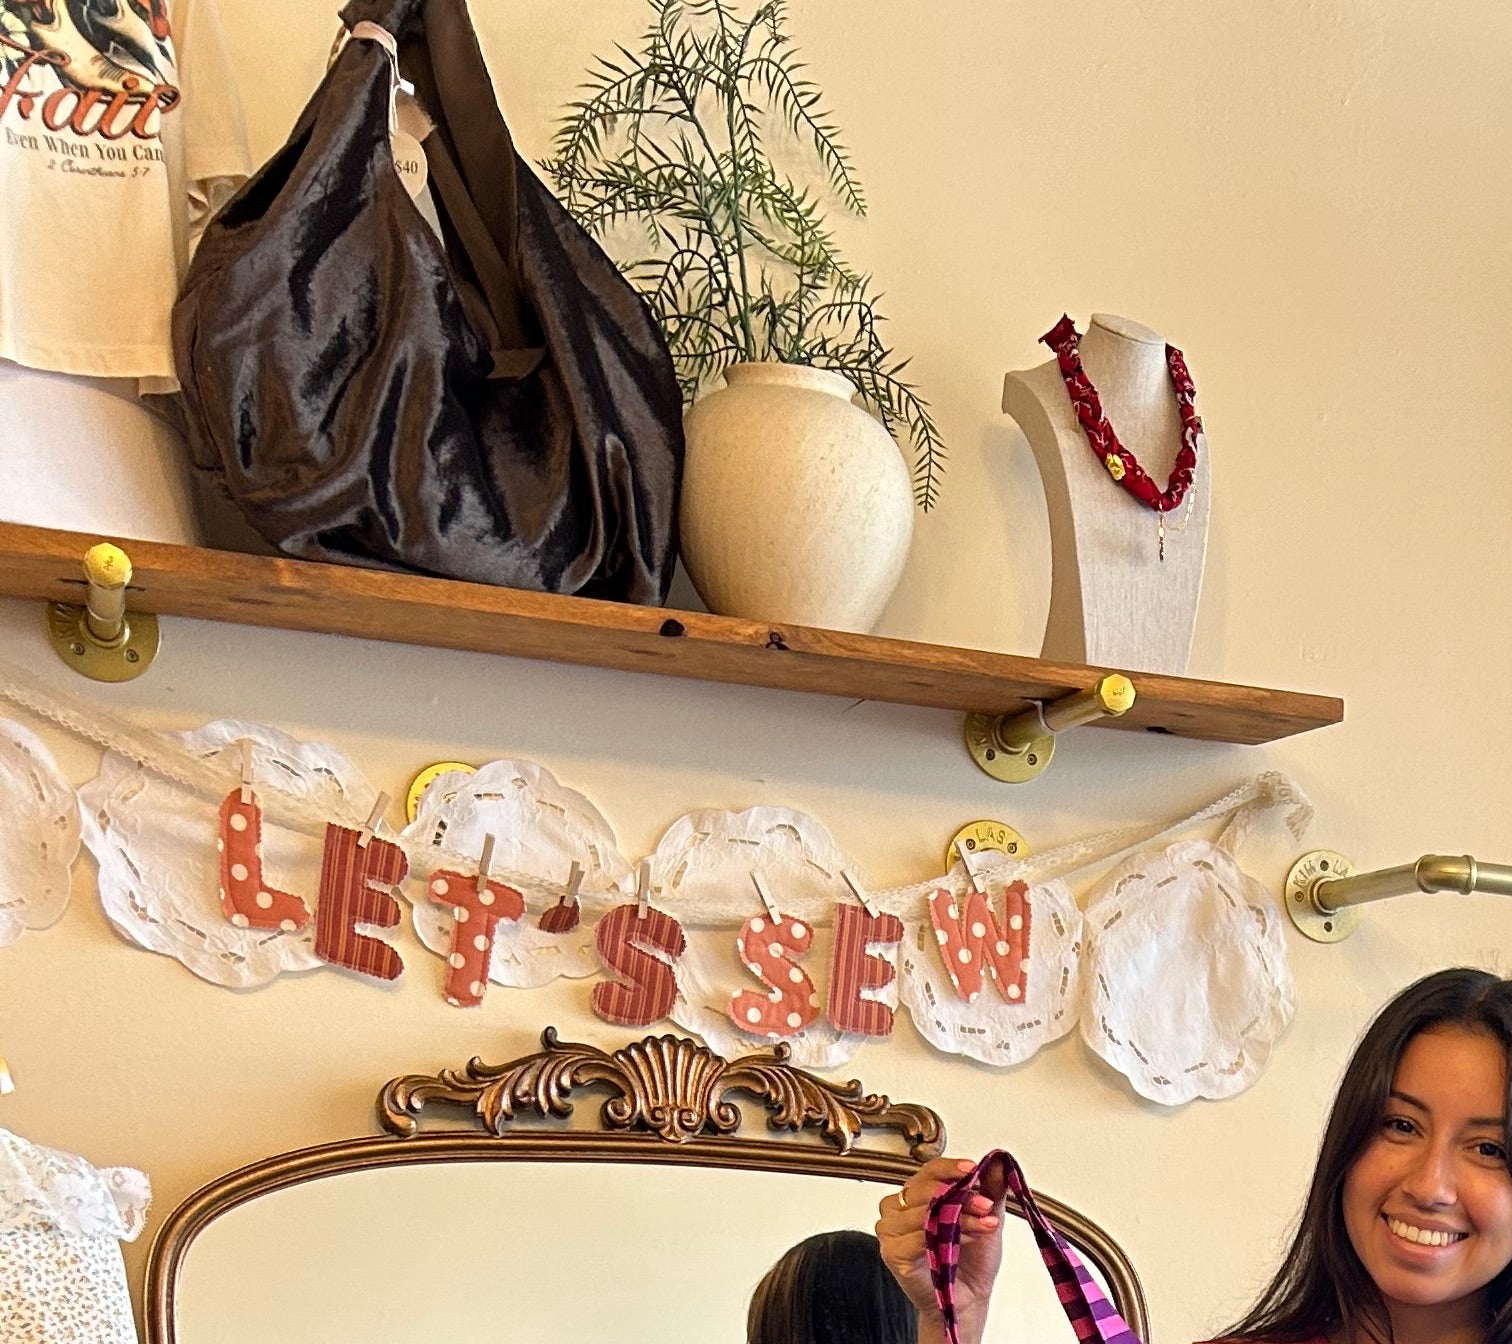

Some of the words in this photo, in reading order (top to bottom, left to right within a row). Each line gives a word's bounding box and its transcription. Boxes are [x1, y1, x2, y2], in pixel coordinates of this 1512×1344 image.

[42, 134, 90, 159] When
[95, 144, 128, 162] You
[394, 160, 419, 175] $40
[217, 786, 689, 1028] LET'S
[726, 878, 1032, 1038] SEW
